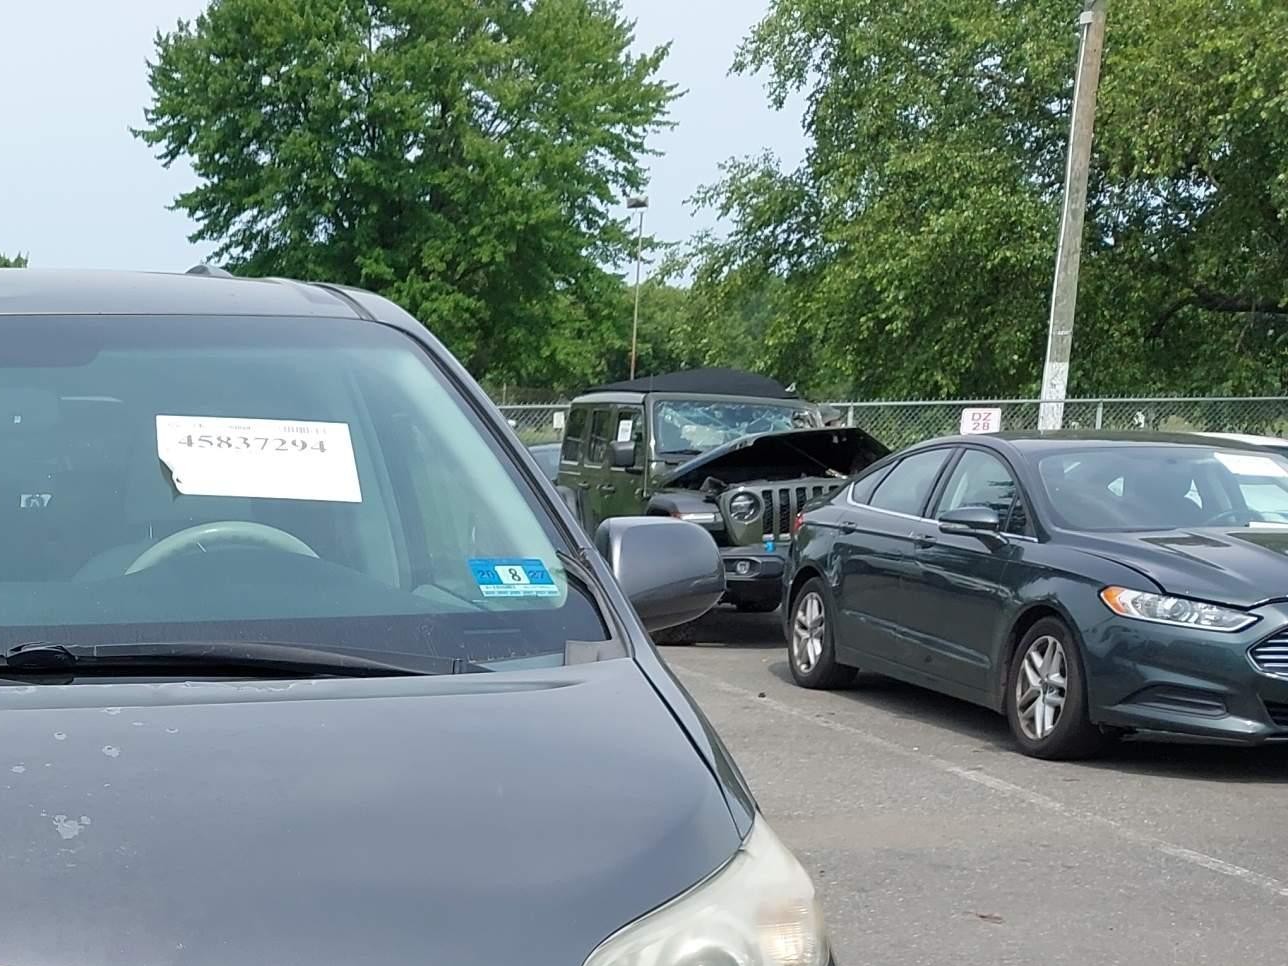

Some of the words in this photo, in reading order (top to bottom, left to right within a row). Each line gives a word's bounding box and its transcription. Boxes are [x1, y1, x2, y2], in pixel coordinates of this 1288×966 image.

[971, 412, 992, 421] DZ
[972, 422, 990, 431] 28
[178, 434, 328, 454] 45837294
[508, 567, 522, 582] 8
